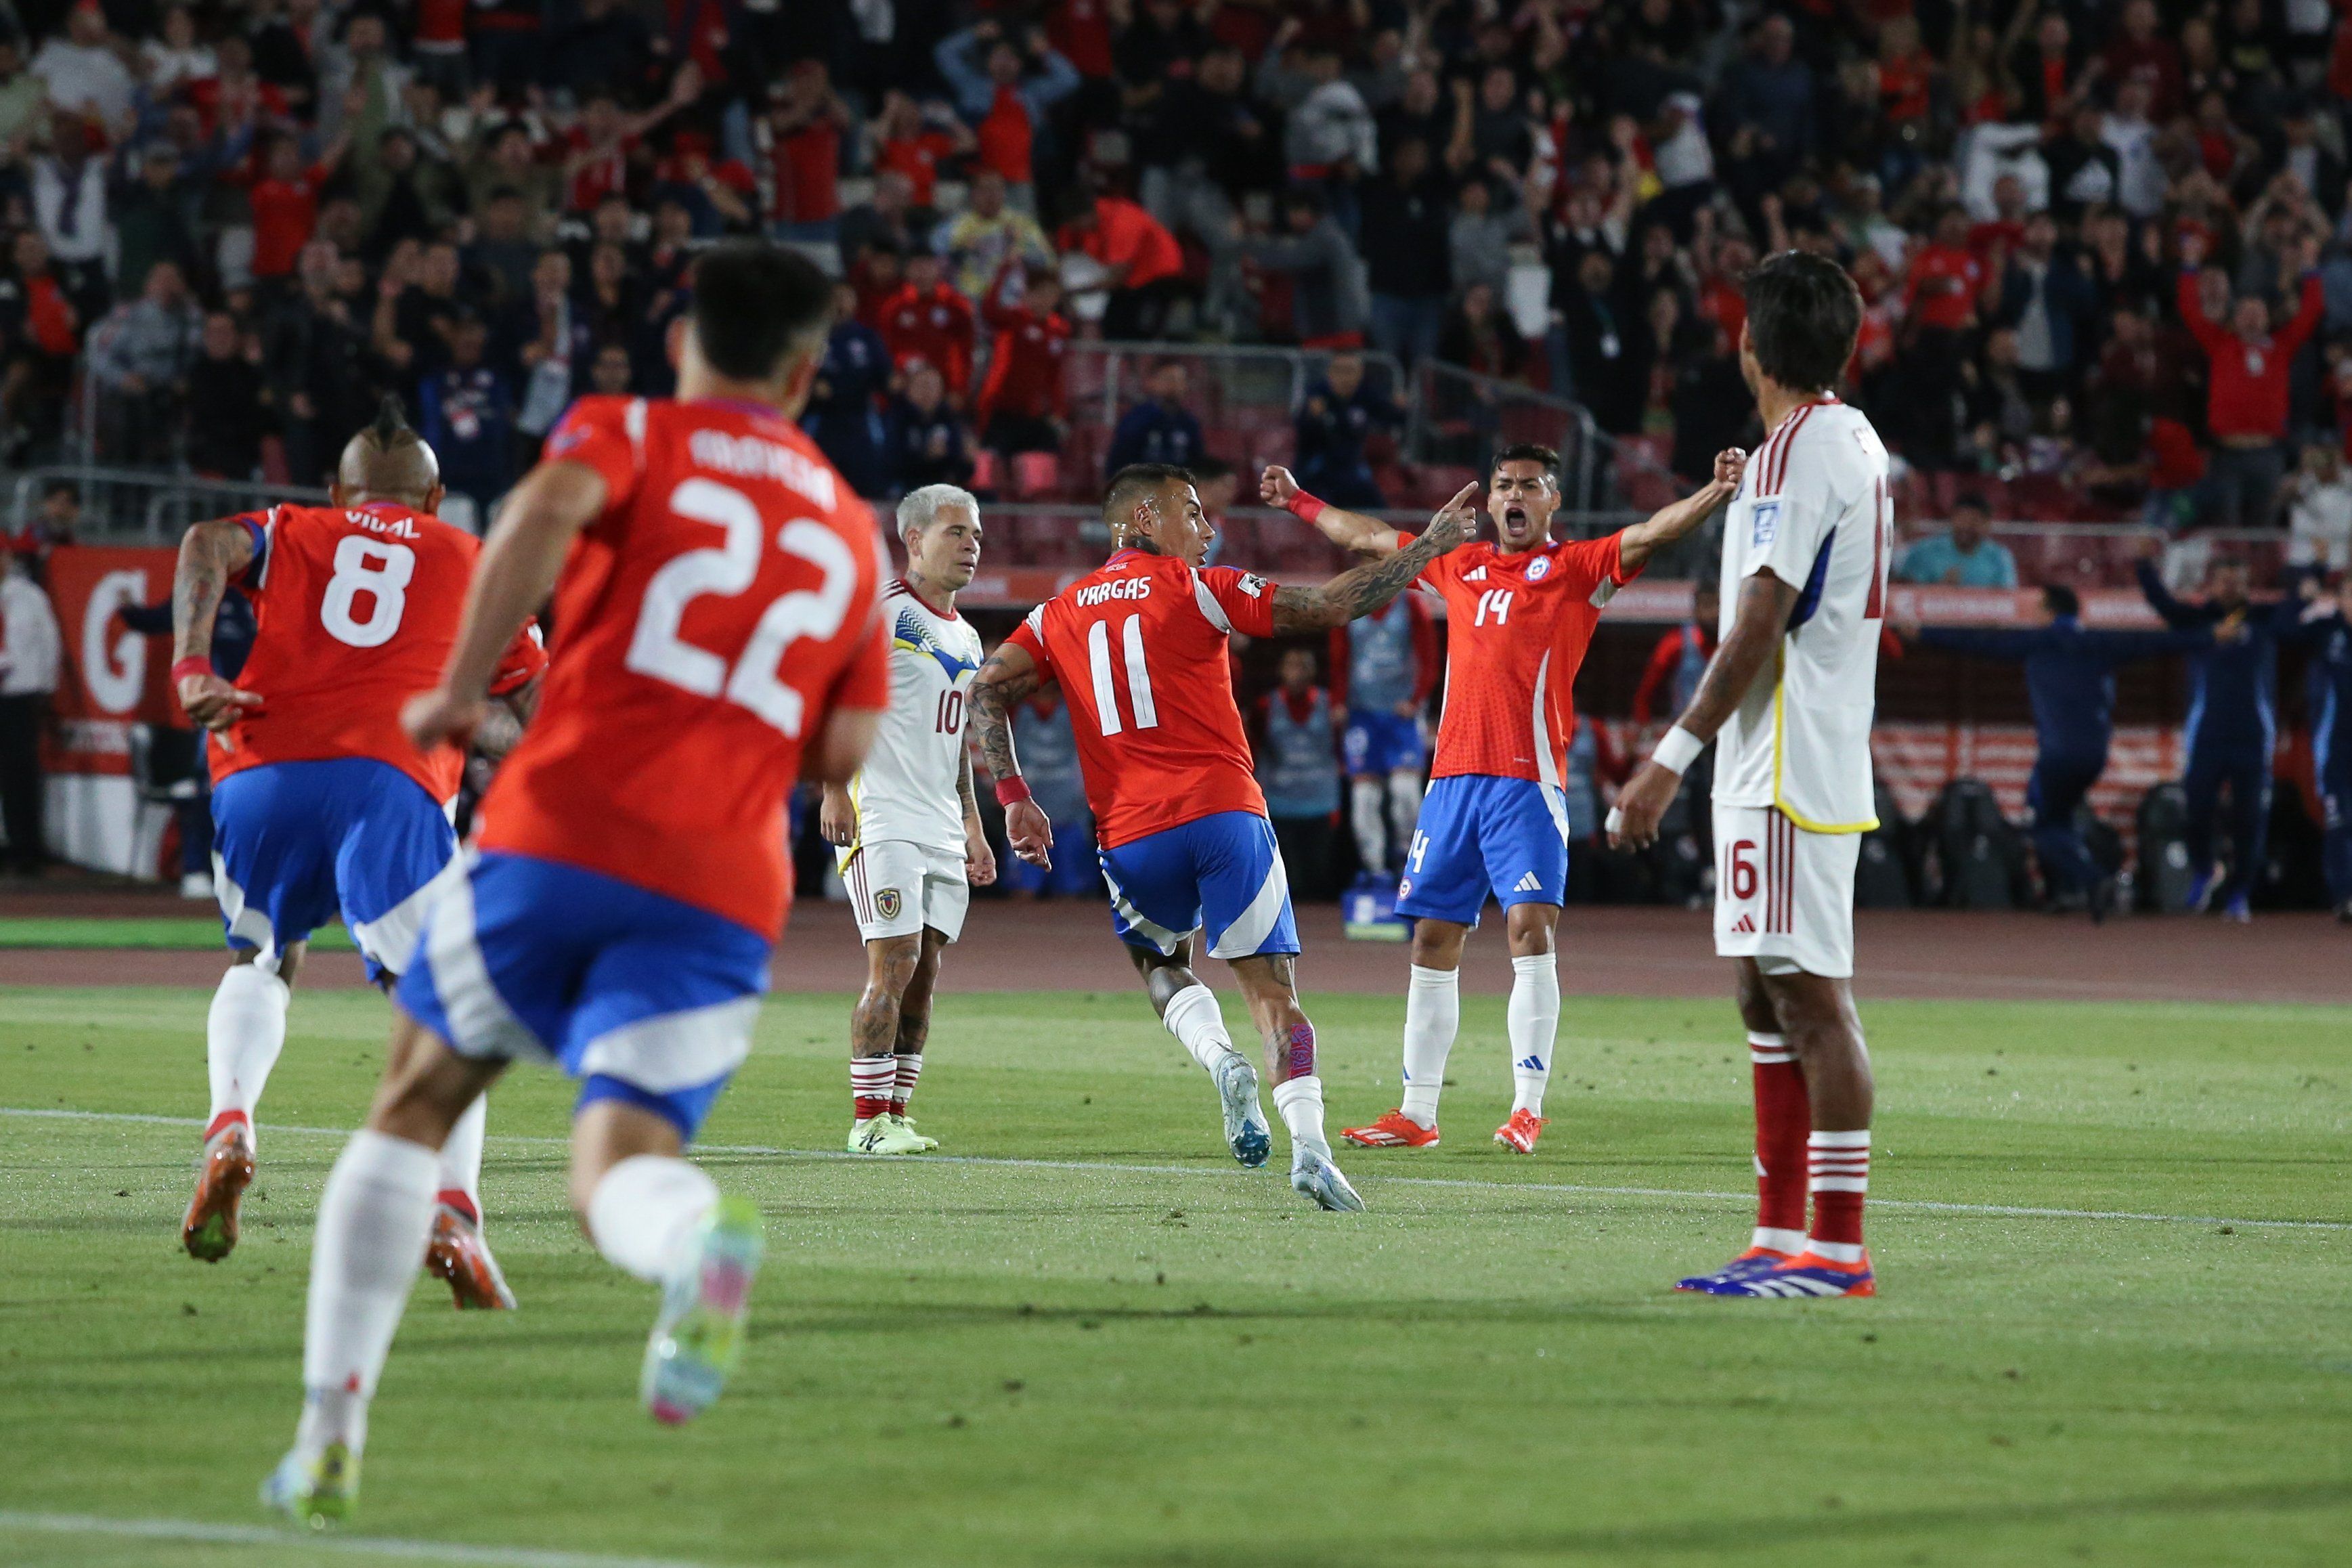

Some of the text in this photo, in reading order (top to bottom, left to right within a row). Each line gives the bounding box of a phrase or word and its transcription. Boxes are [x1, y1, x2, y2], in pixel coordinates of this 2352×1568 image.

[82, 568, 147, 714] G
[320, 534, 416, 648] 8
[624, 475, 857, 739] 22
[1076, 576, 1152, 607] VARGAS
[1473, 588, 1515, 627] 14
[935, 689, 963, 735] 10
[1087, 613, 1158, 737] 11
